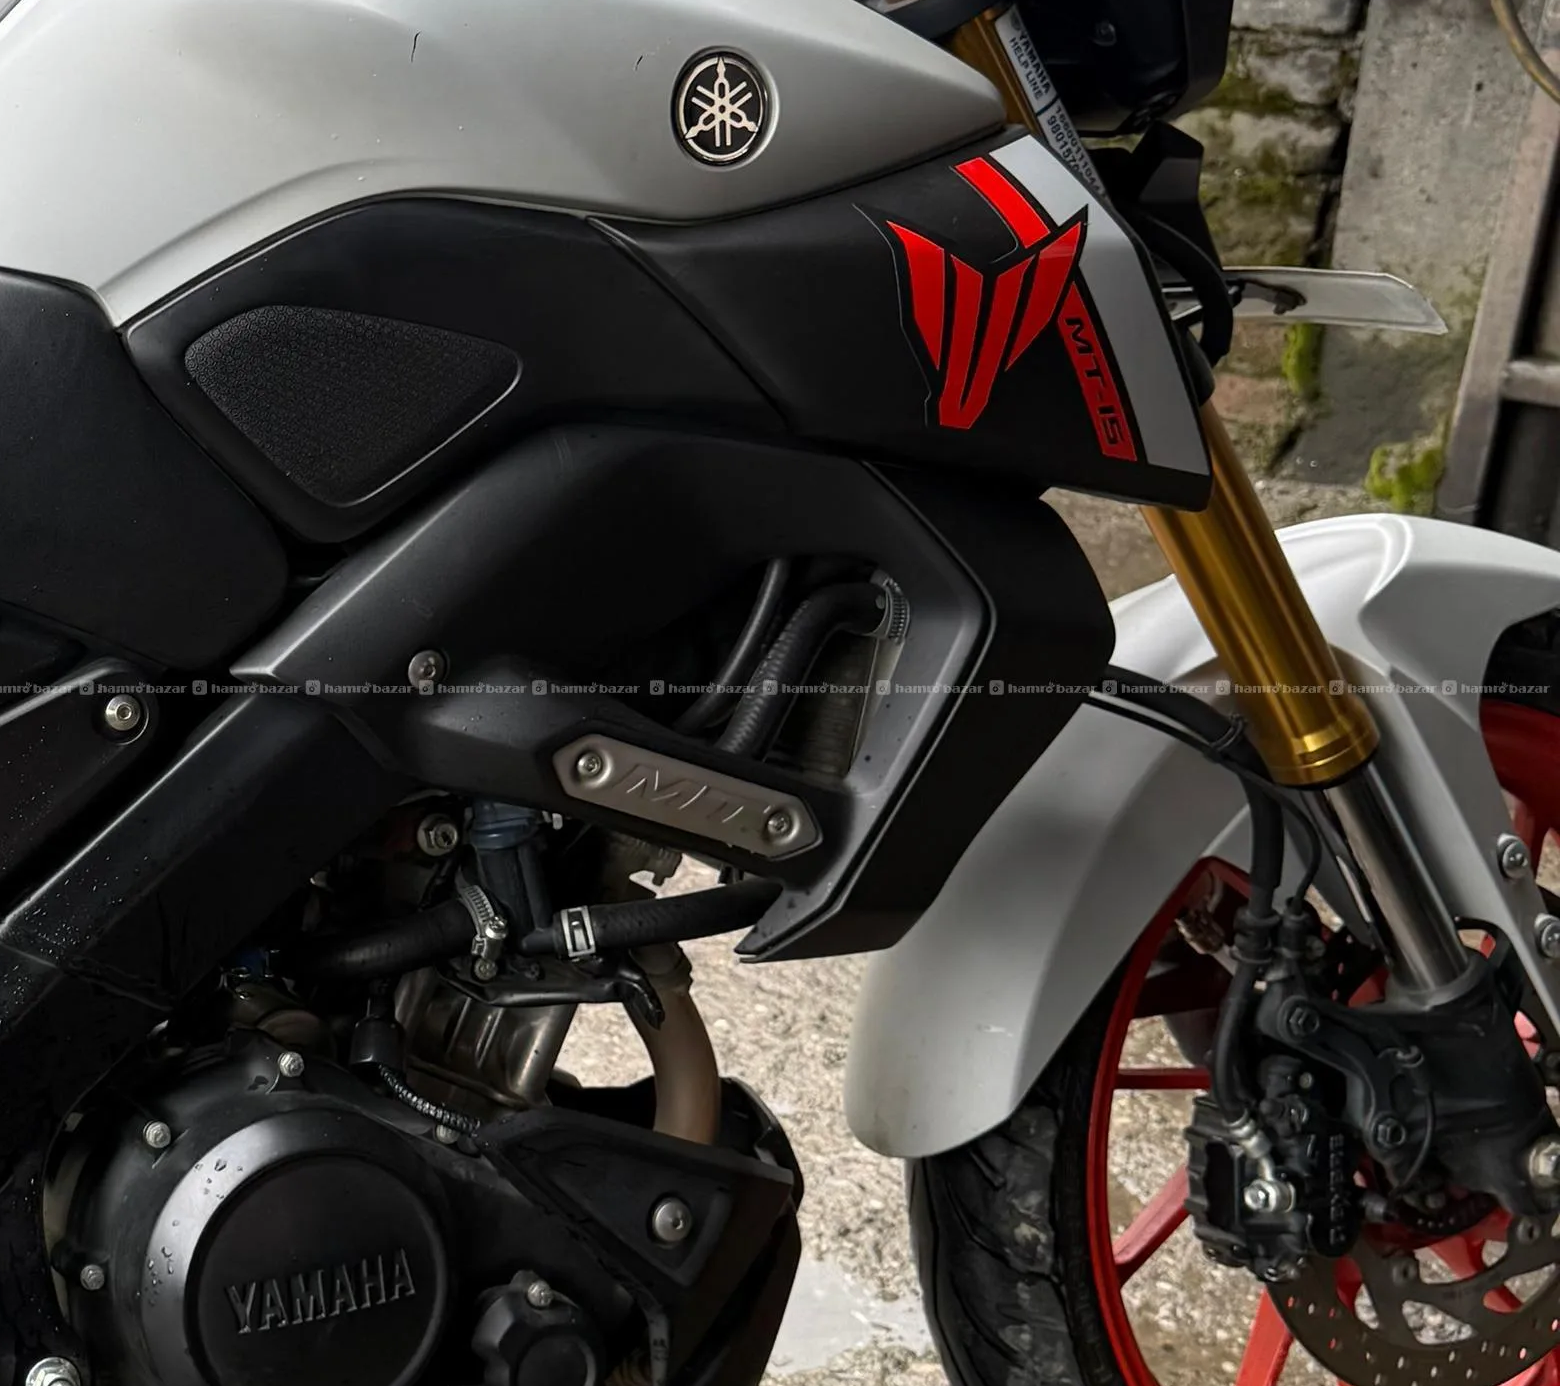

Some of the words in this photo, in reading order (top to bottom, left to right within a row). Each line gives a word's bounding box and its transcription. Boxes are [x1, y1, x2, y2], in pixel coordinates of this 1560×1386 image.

[1008, 36, 1031, 71] HELP
[1025, 68, 1045, 101] LINE
[1017, 29, 1053, 96] YAMAHA
[1065, 317, 1125, 445] MT-15
[225, 1247, 416, 1335] YAMAHA
